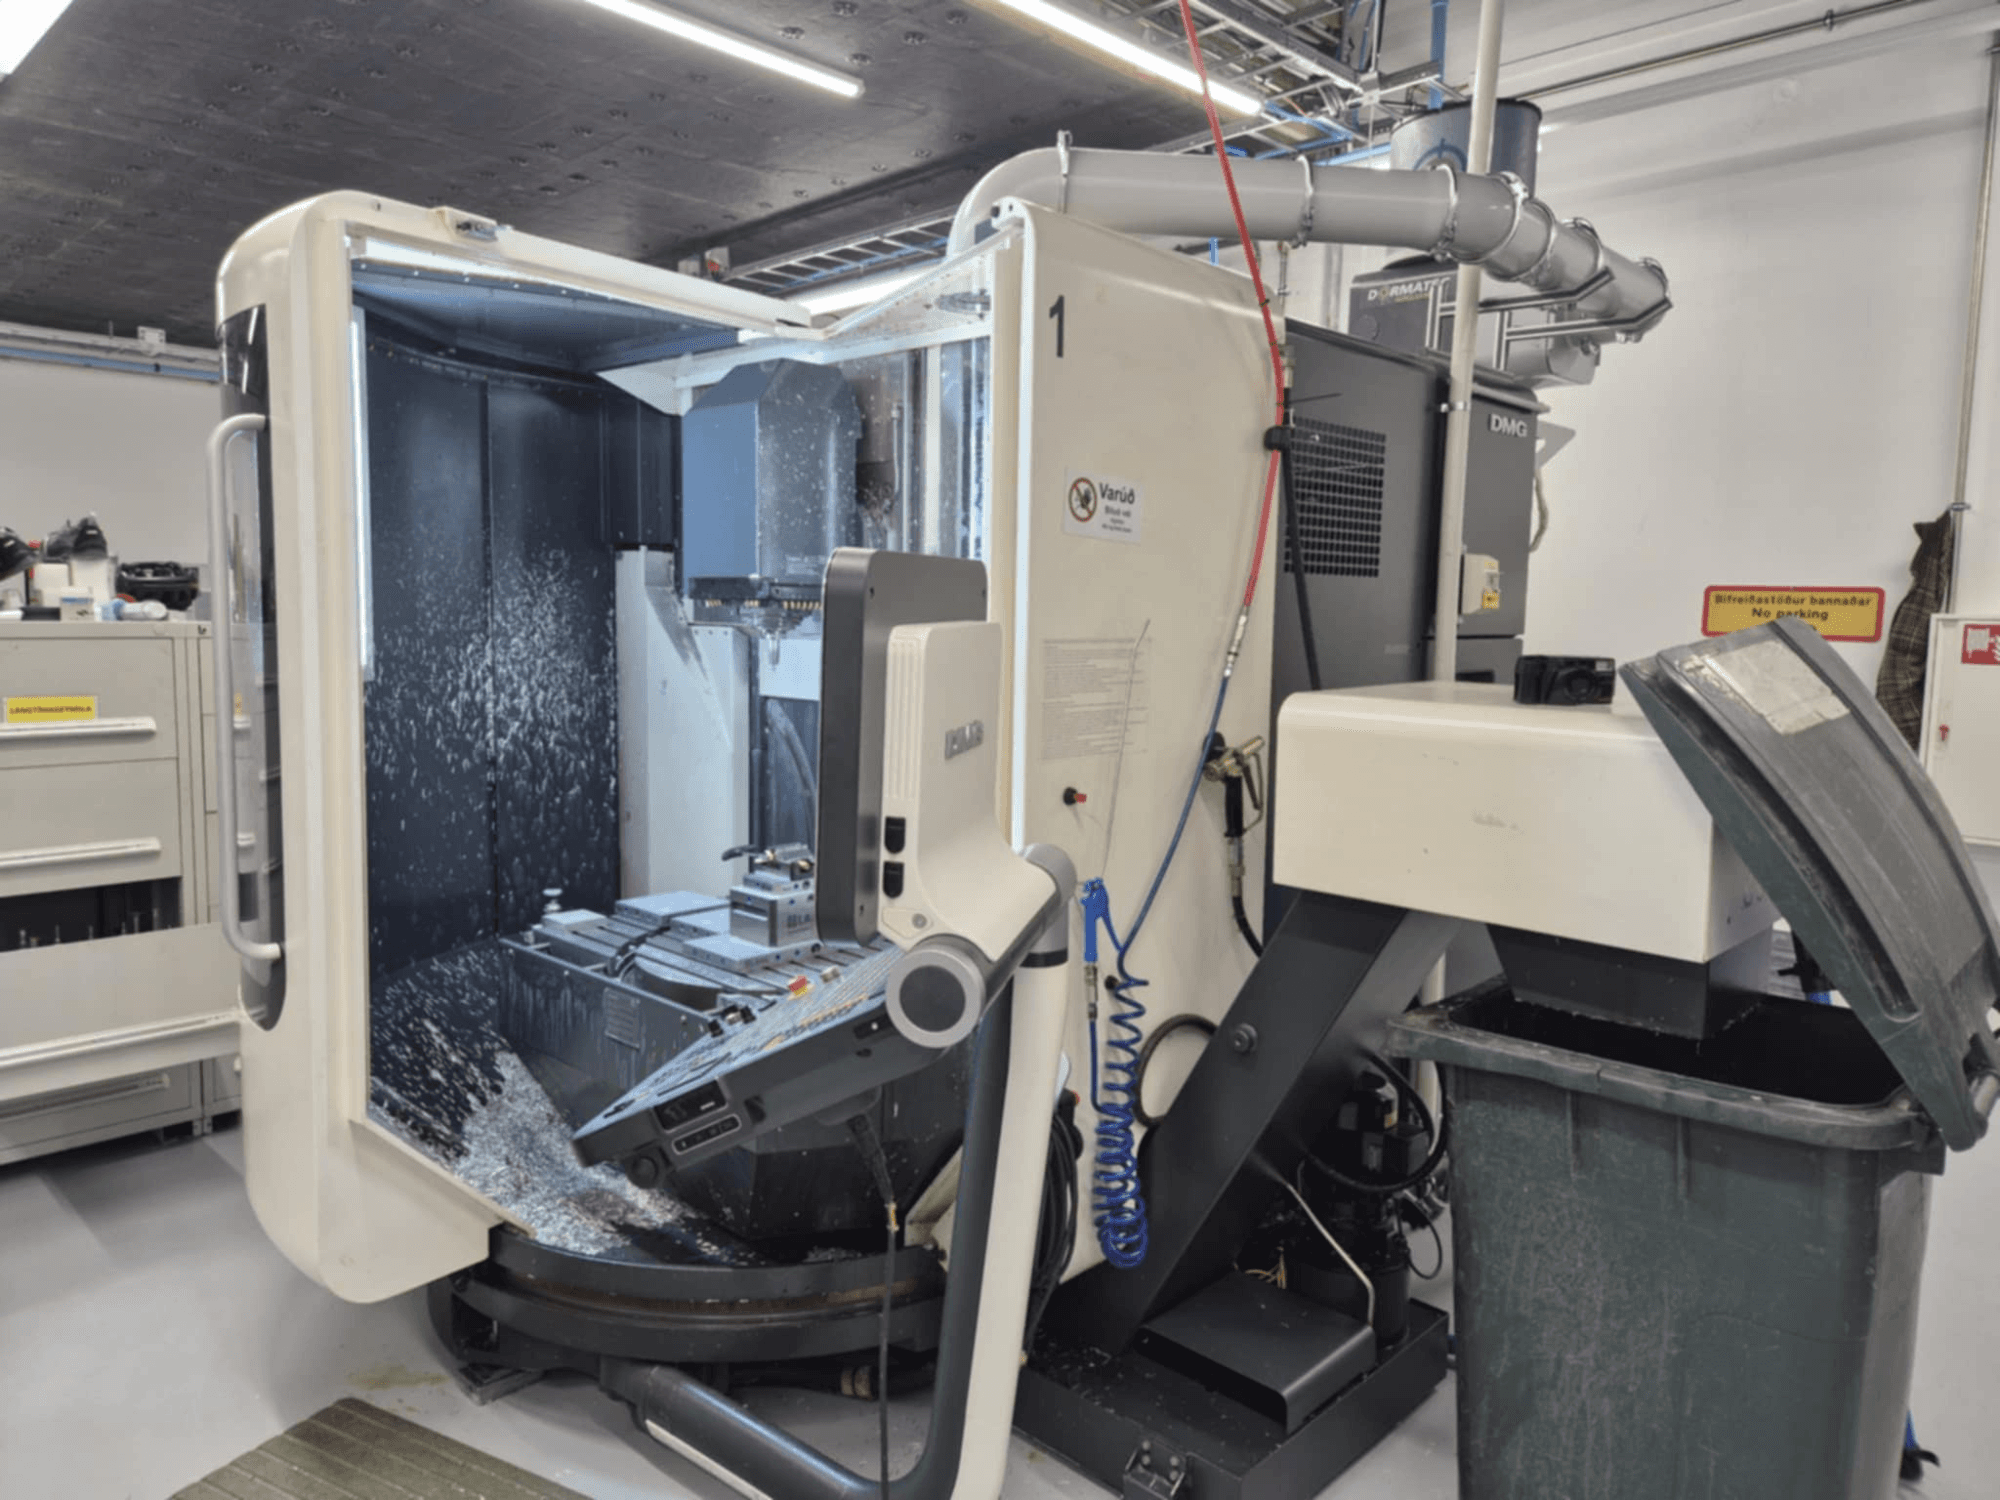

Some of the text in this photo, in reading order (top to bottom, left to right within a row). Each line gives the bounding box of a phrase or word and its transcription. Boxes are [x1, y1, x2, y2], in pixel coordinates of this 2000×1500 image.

[1049, 295, 1065, 358] 1
[1490, 414, 1528, 438] DMG
[1098, 481, 1135, 505] Varúð
[1751, 607, 1829, 621] No parking
